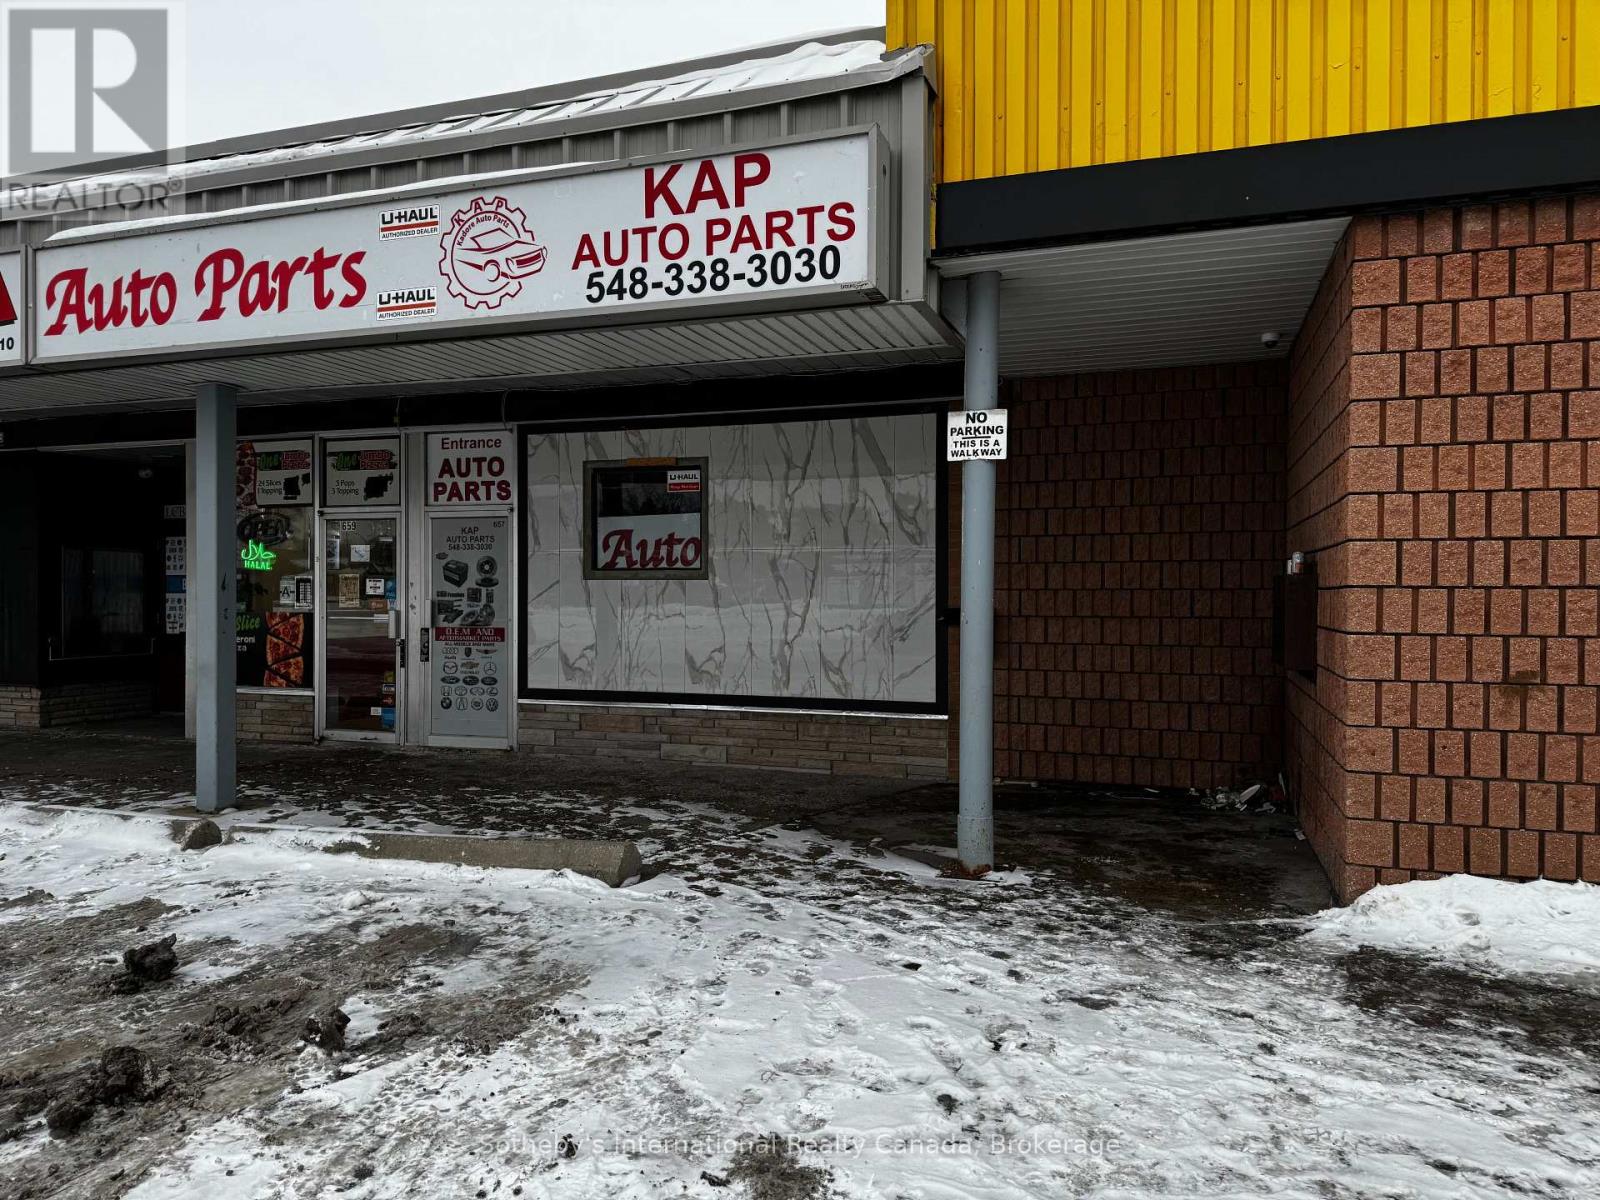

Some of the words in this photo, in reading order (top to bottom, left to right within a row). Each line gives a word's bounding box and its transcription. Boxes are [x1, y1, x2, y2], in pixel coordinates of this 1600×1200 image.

[646, 154, 771, 218] KAP
[381, 207, 438, 225] U-HAUL
[382, 229, 416, 239] AUTHORIZED
[416, 227, 438, 235] DEALER
[456, 222, 476, 247] Kadore
[475, 214, 493, 225] Auto
[493, 214, 510, 229] Parts
[572, 233, 690, 271] AUTO
[705, 201, 856, 258] PARTS
[586, 245, 841, 302] 548-338-3030
[44, 267, 178, 337] Auto
[194, 247, 367, 322] Parts
[379, 288, 436, 305] U-HAUL
[379, 311, 413, 319] AUTHORIZED
[966, 412, 988, 424] NO
[950, 425, 1004, 437] PARKING
[441, 438, 502, 451] Entrance
[953, 440, 977, 449] THIS
[980, 440, 990, 448] IS
[951, 448, 1003, 458] WALKWAY
[438, 456, 505, 479] AUTO
[433, 480, 512, 502] PARTS
[343, 521, 357, 531] 659
[461, 526, 479, 535] KAP
[602, 529, 702, 570] Auto
[244, 560, 272, 571] HALAL
[475, 628, 496, 636] AND
